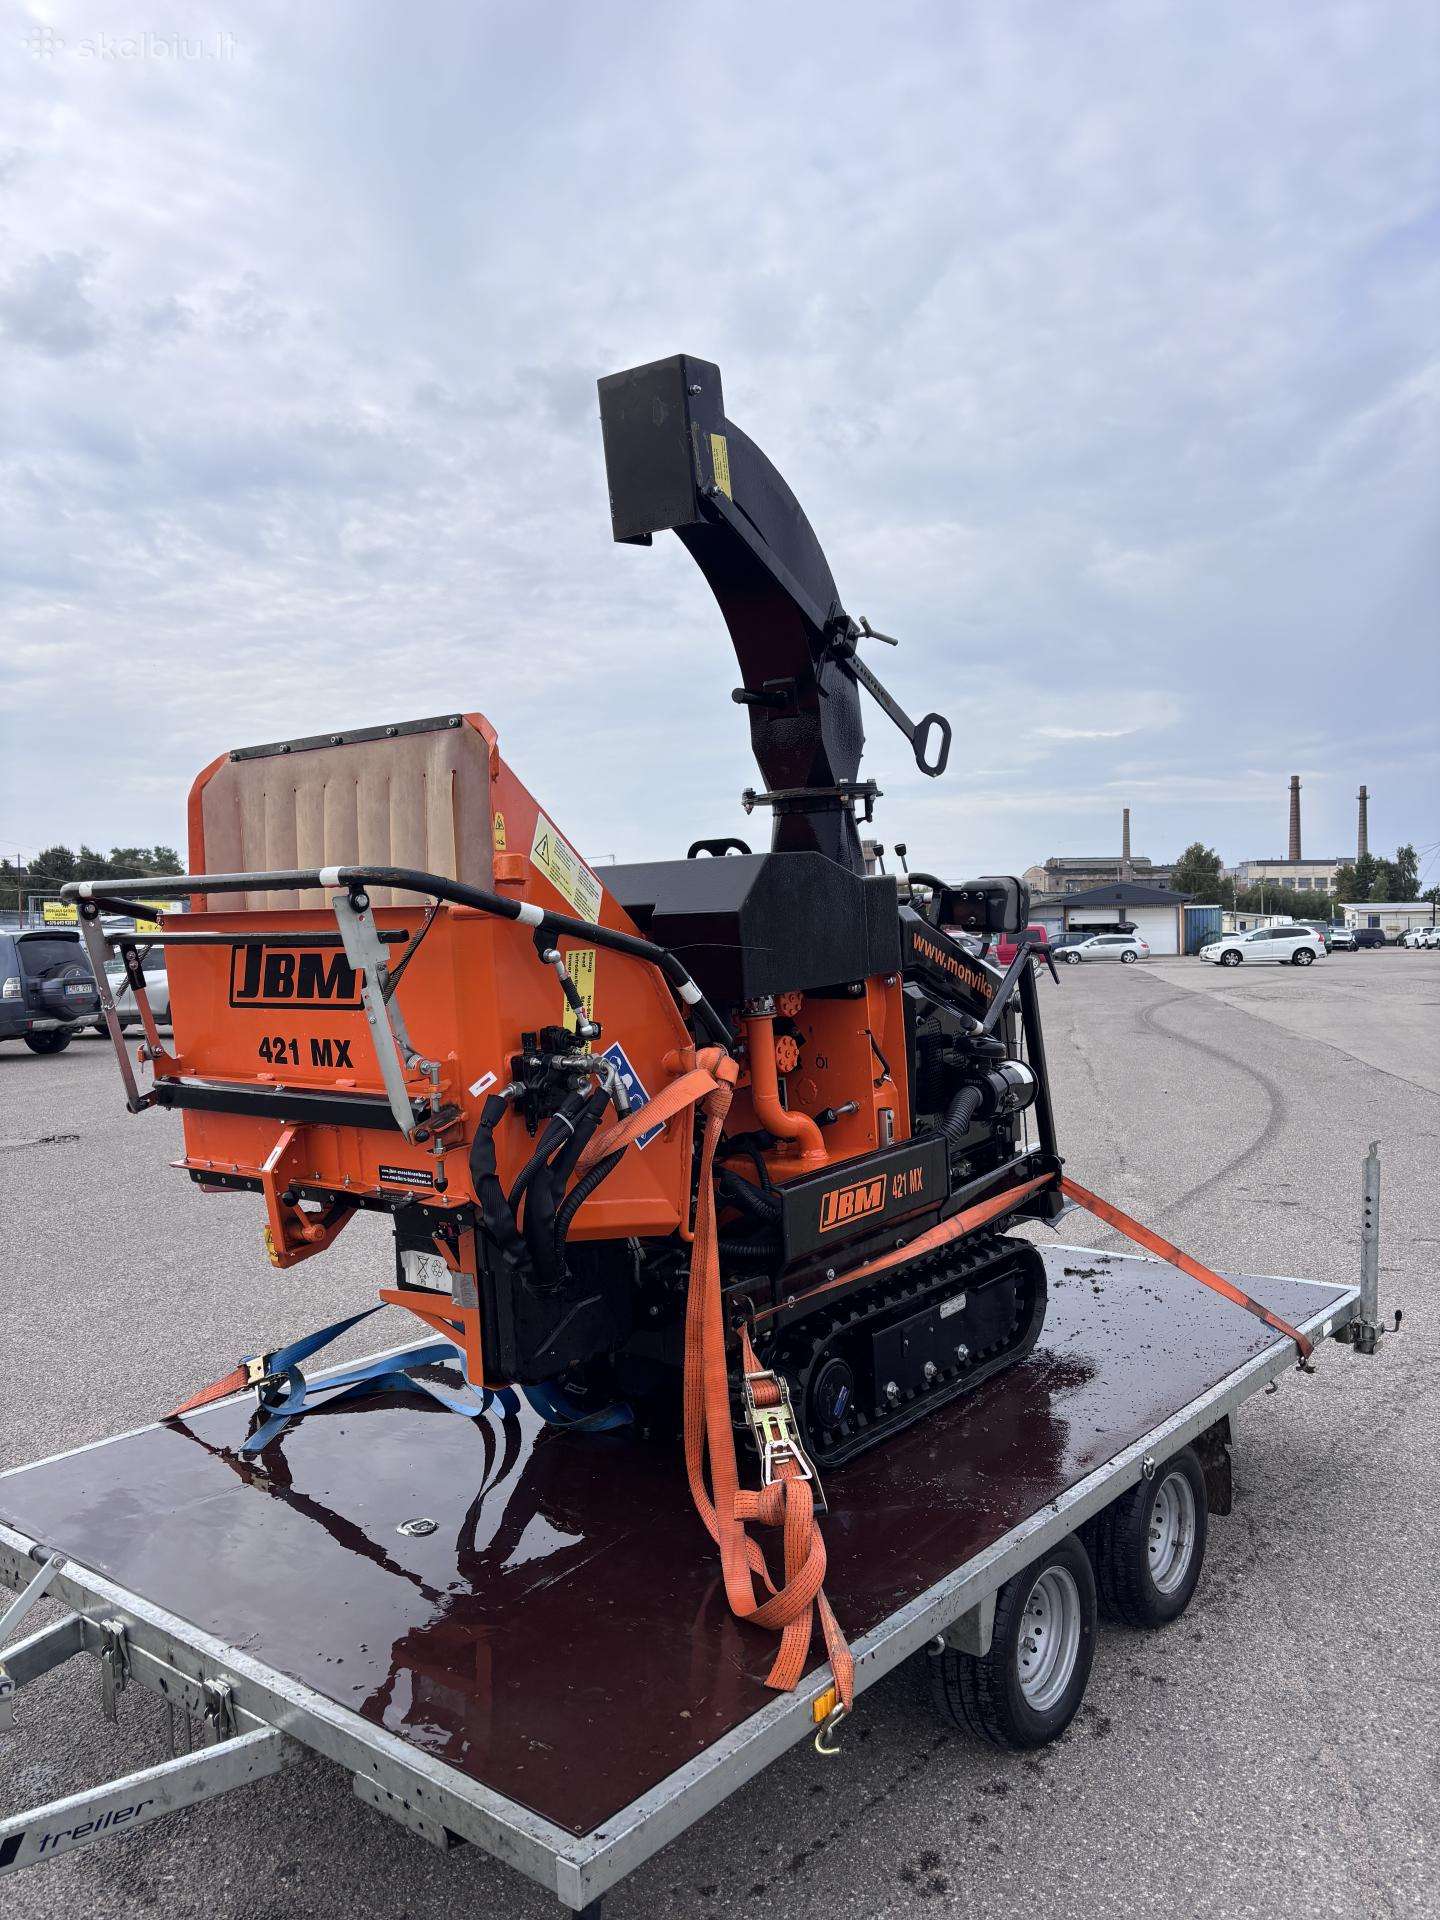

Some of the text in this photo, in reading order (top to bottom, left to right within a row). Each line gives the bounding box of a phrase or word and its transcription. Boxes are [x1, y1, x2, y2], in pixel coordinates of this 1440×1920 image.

[236, 944, 357, 999] JBM
[258, 1036, 355, 1069] 421 MX
[823, 1166, 924, 1226] JBM 421 MX
[39, 1799, 154, 1853] treiler
